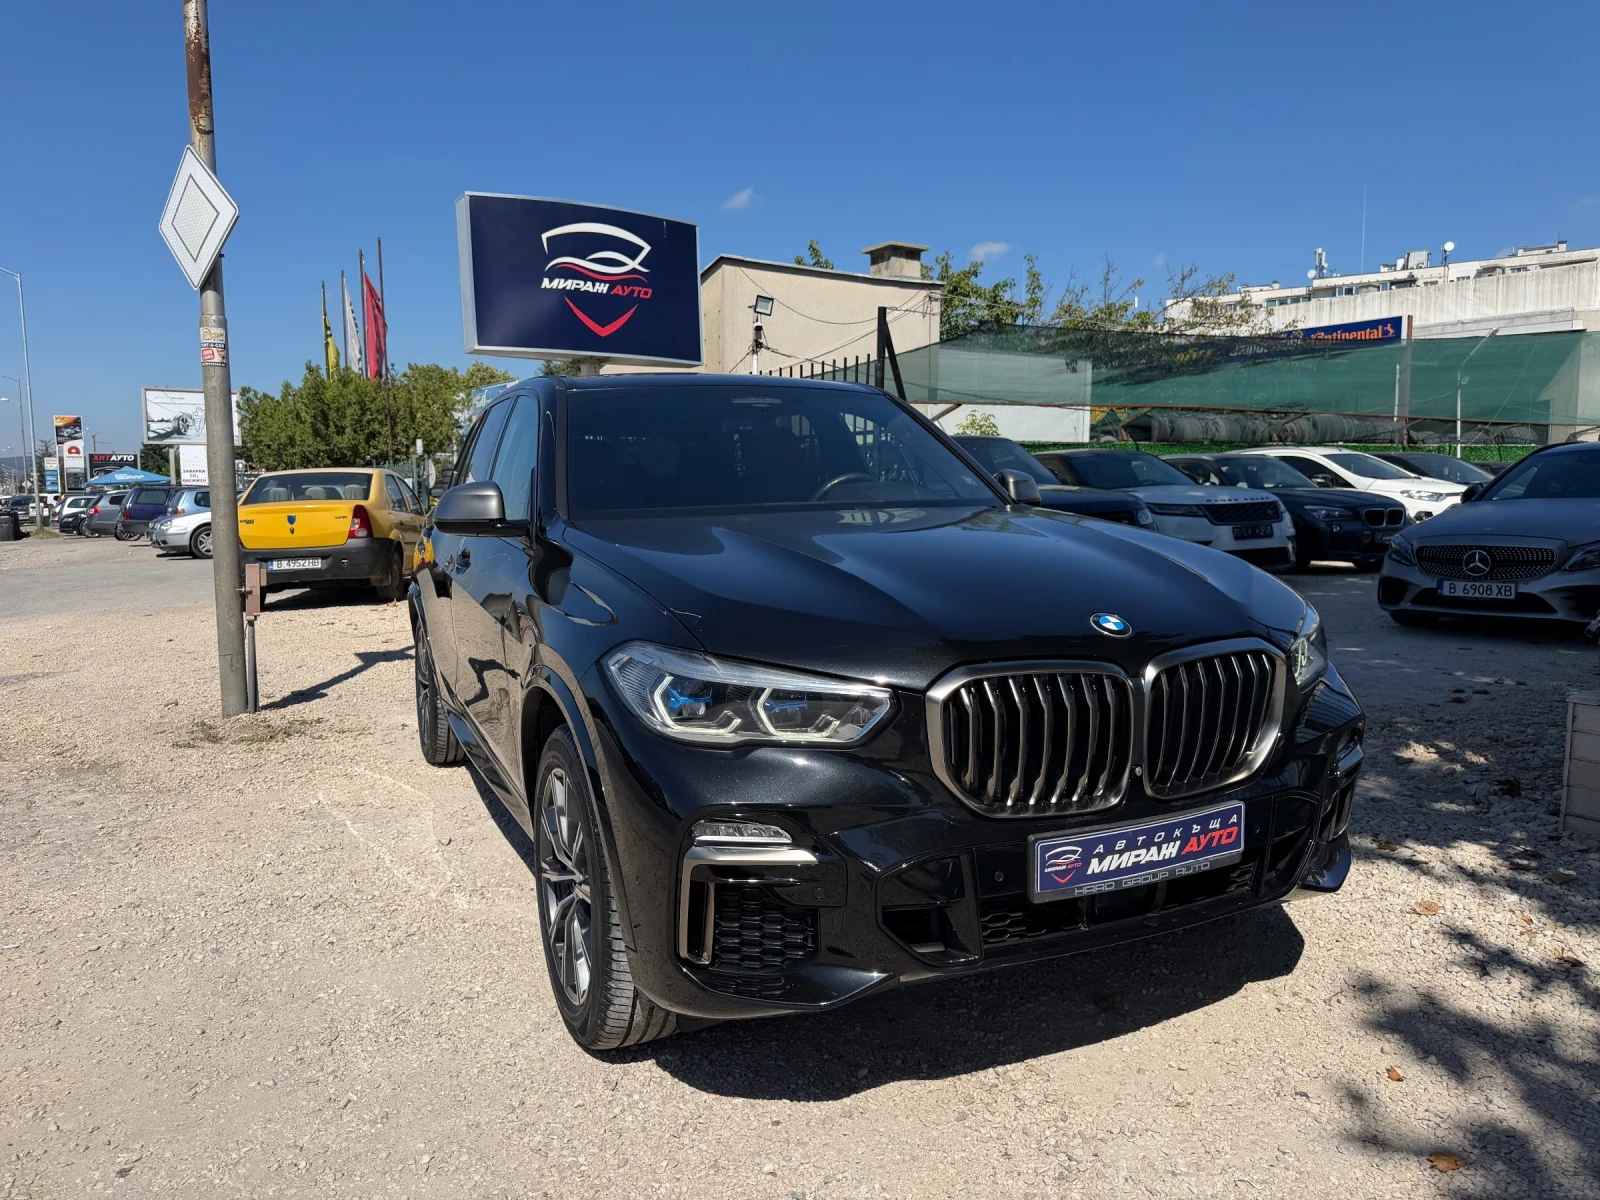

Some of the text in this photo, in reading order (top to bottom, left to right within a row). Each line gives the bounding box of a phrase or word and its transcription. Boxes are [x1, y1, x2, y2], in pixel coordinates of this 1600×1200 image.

[541, 278, 653, 299] МИРАЖ АУТО
[276, 559, 320, 568] B 4952 HB
[1449, 583, 1513, 597] B 6908 XB
[1093, 814, 1238, 854] АВТОКЪЩА
[1086, 826, 1239, 875] МИРАЖ АУТО
[1044, 864, 1066, 873] МИРАЖ
[1074, 861, 1210, 896] HARD GROUP AUTO
